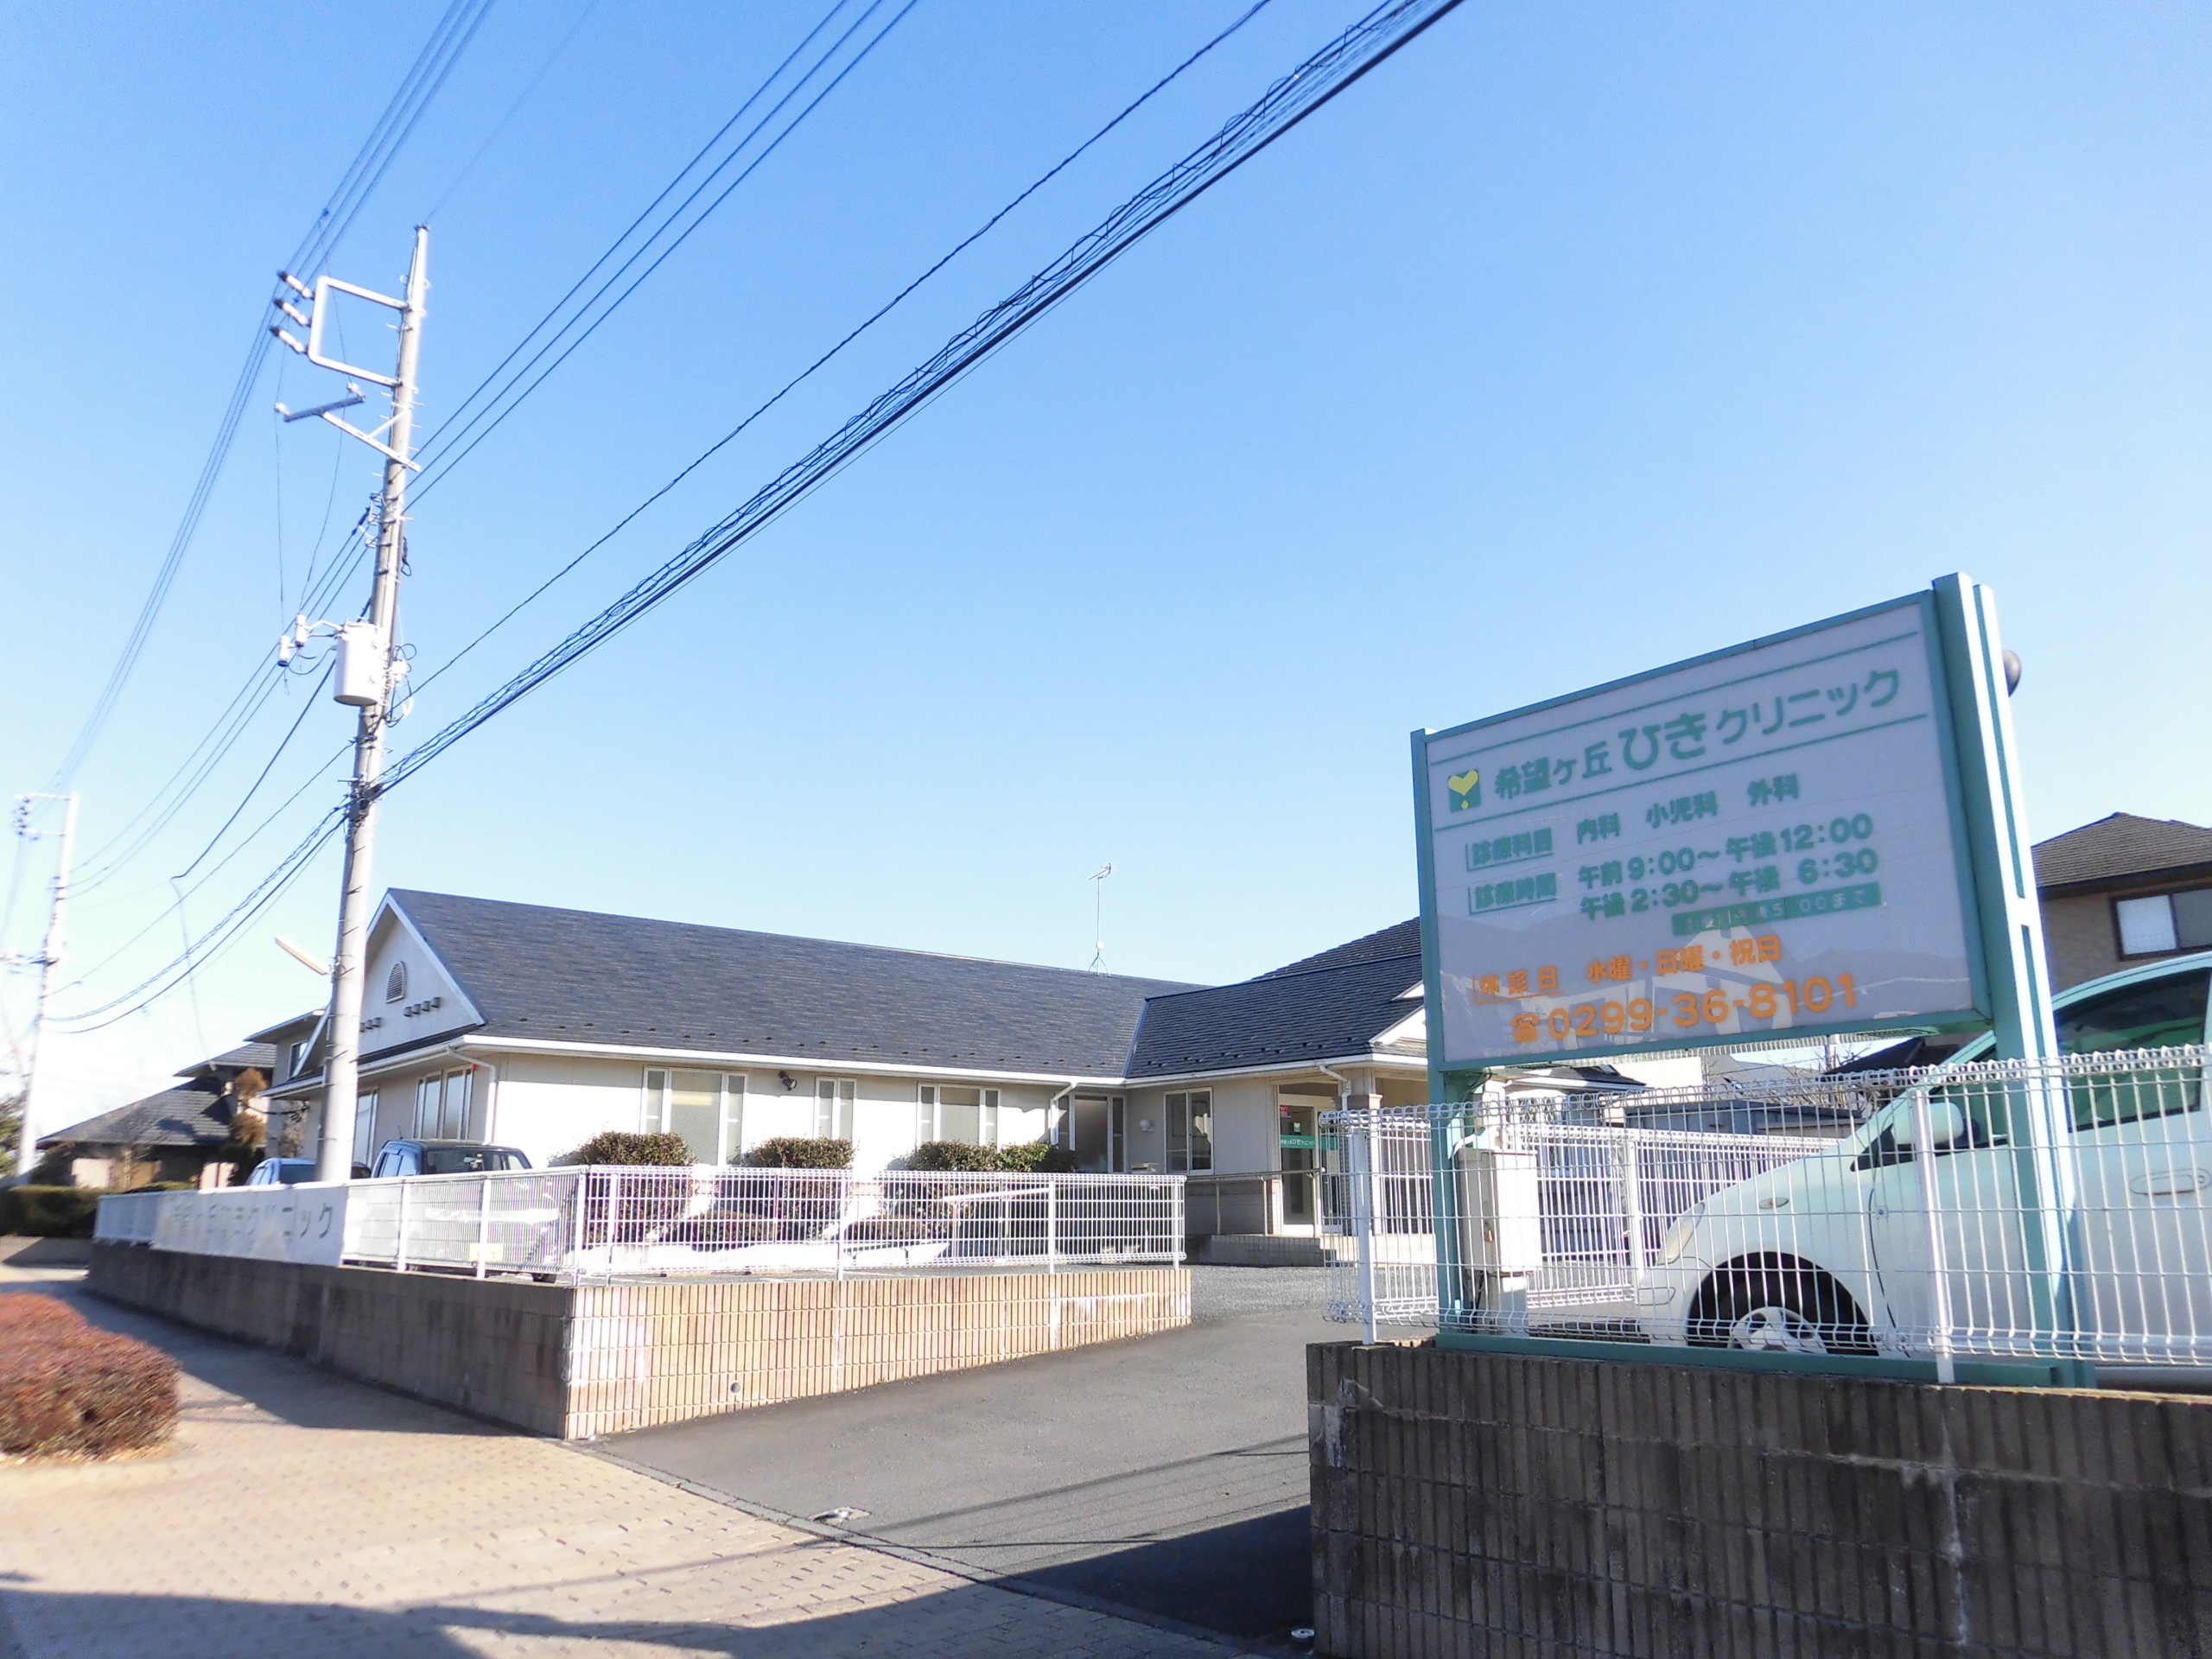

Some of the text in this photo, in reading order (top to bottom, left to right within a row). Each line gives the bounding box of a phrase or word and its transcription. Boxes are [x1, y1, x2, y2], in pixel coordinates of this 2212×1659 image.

[1576, 812, 1622, 845] 内科
[1645, 790, 1719, 830] 小児科
[1747, 772, 1801, 807] 外科
[1548, 973, 1855, 1040] 0299-36-8101
